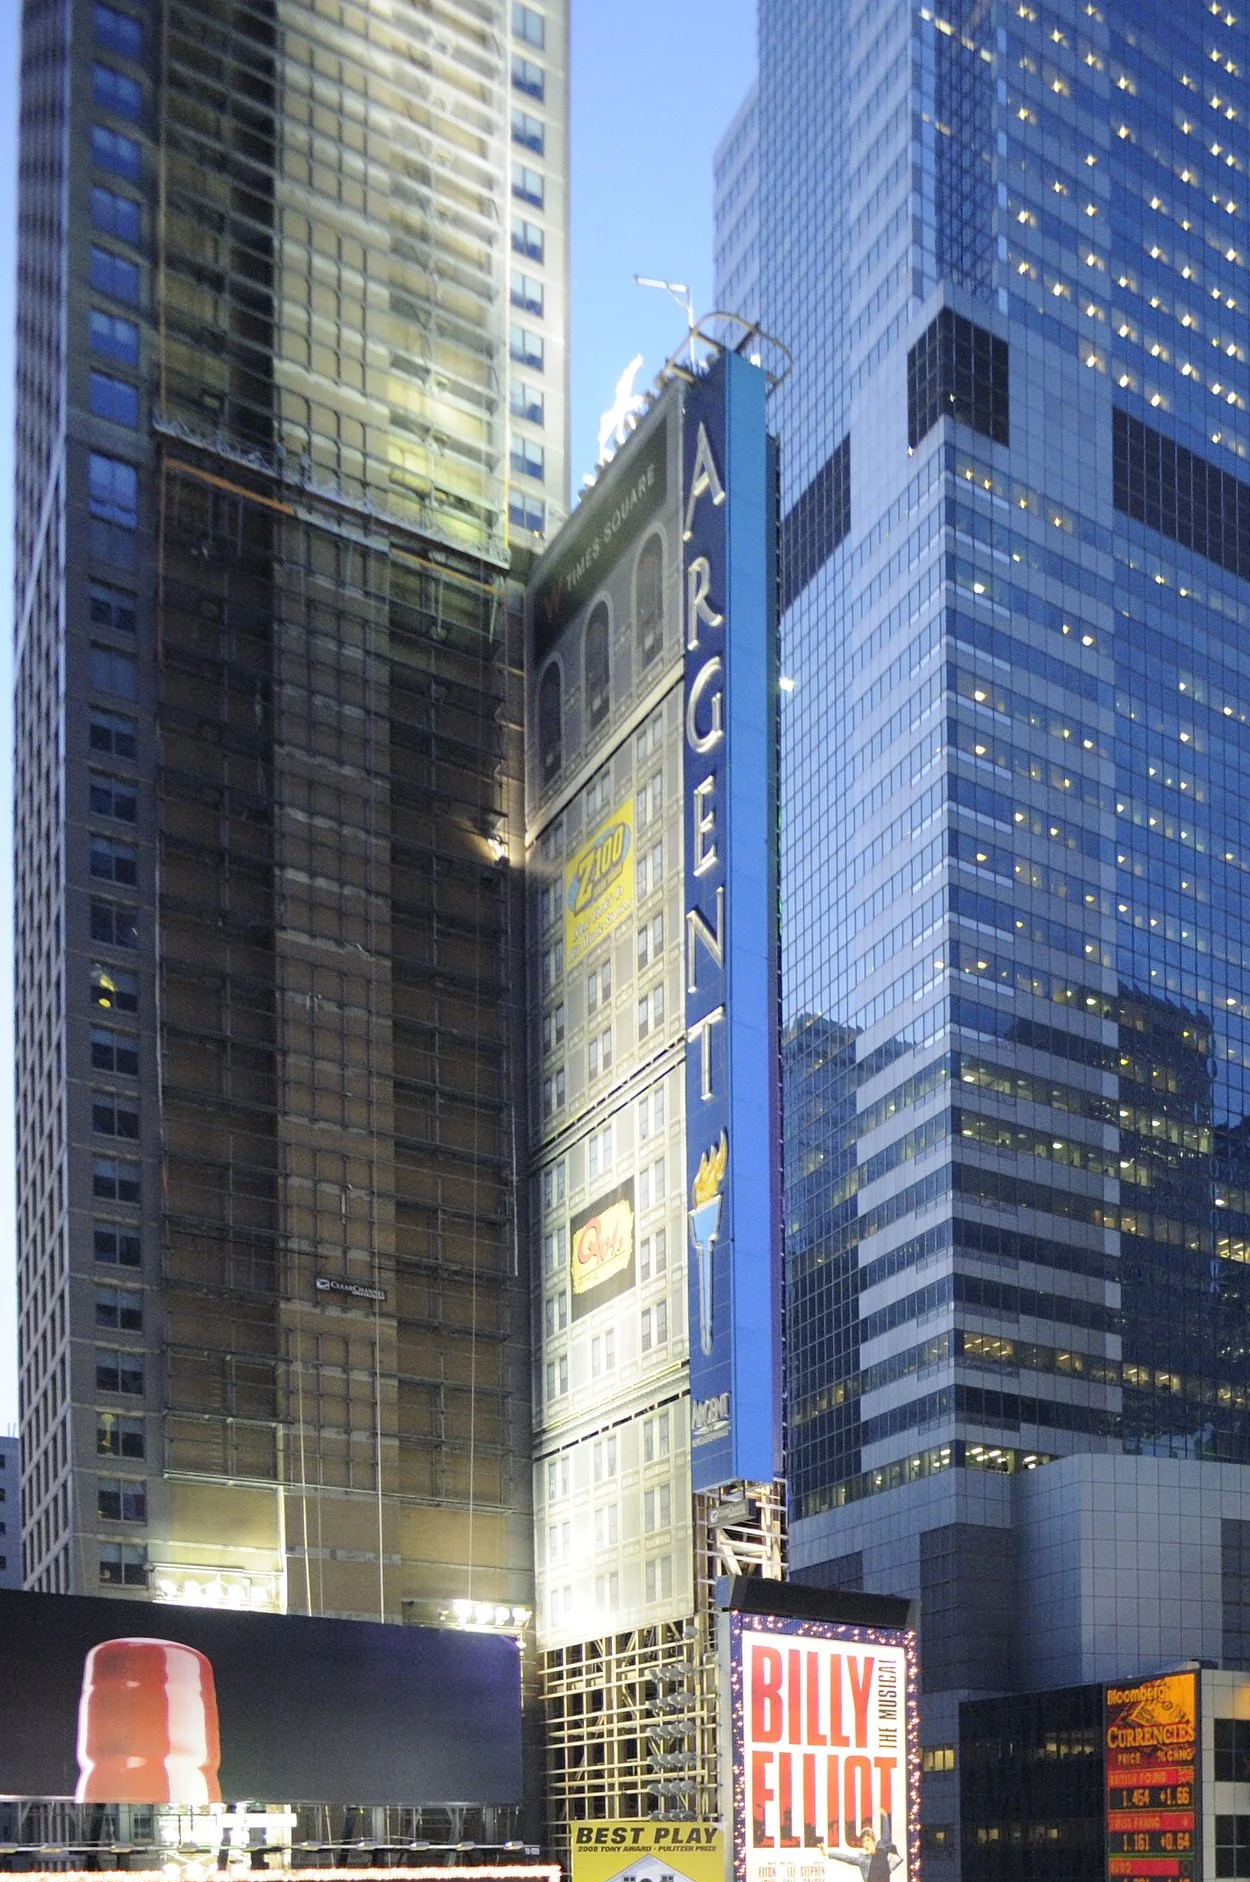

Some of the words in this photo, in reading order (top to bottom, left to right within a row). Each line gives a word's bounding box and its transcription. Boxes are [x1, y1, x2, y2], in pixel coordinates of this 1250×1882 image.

[603, 463, 655, 543] SQUARE
[574, 822, 626, 917] Z100
[750, 1644, 875, 1748] BILLY
[878, 1659, 897, 1711] MUSICAL
[1107, 1681, 1167, 1705] Bloomberg
[878, 1716, 897, 1749] THE
[1107, 1724, 1195, 1749] CURRENCIES
[752, 1751, 898, 1848] ELLIOT
[576, 1827, 645, 1845] BEST
[653, 1827, 719, 1845] PLAY
